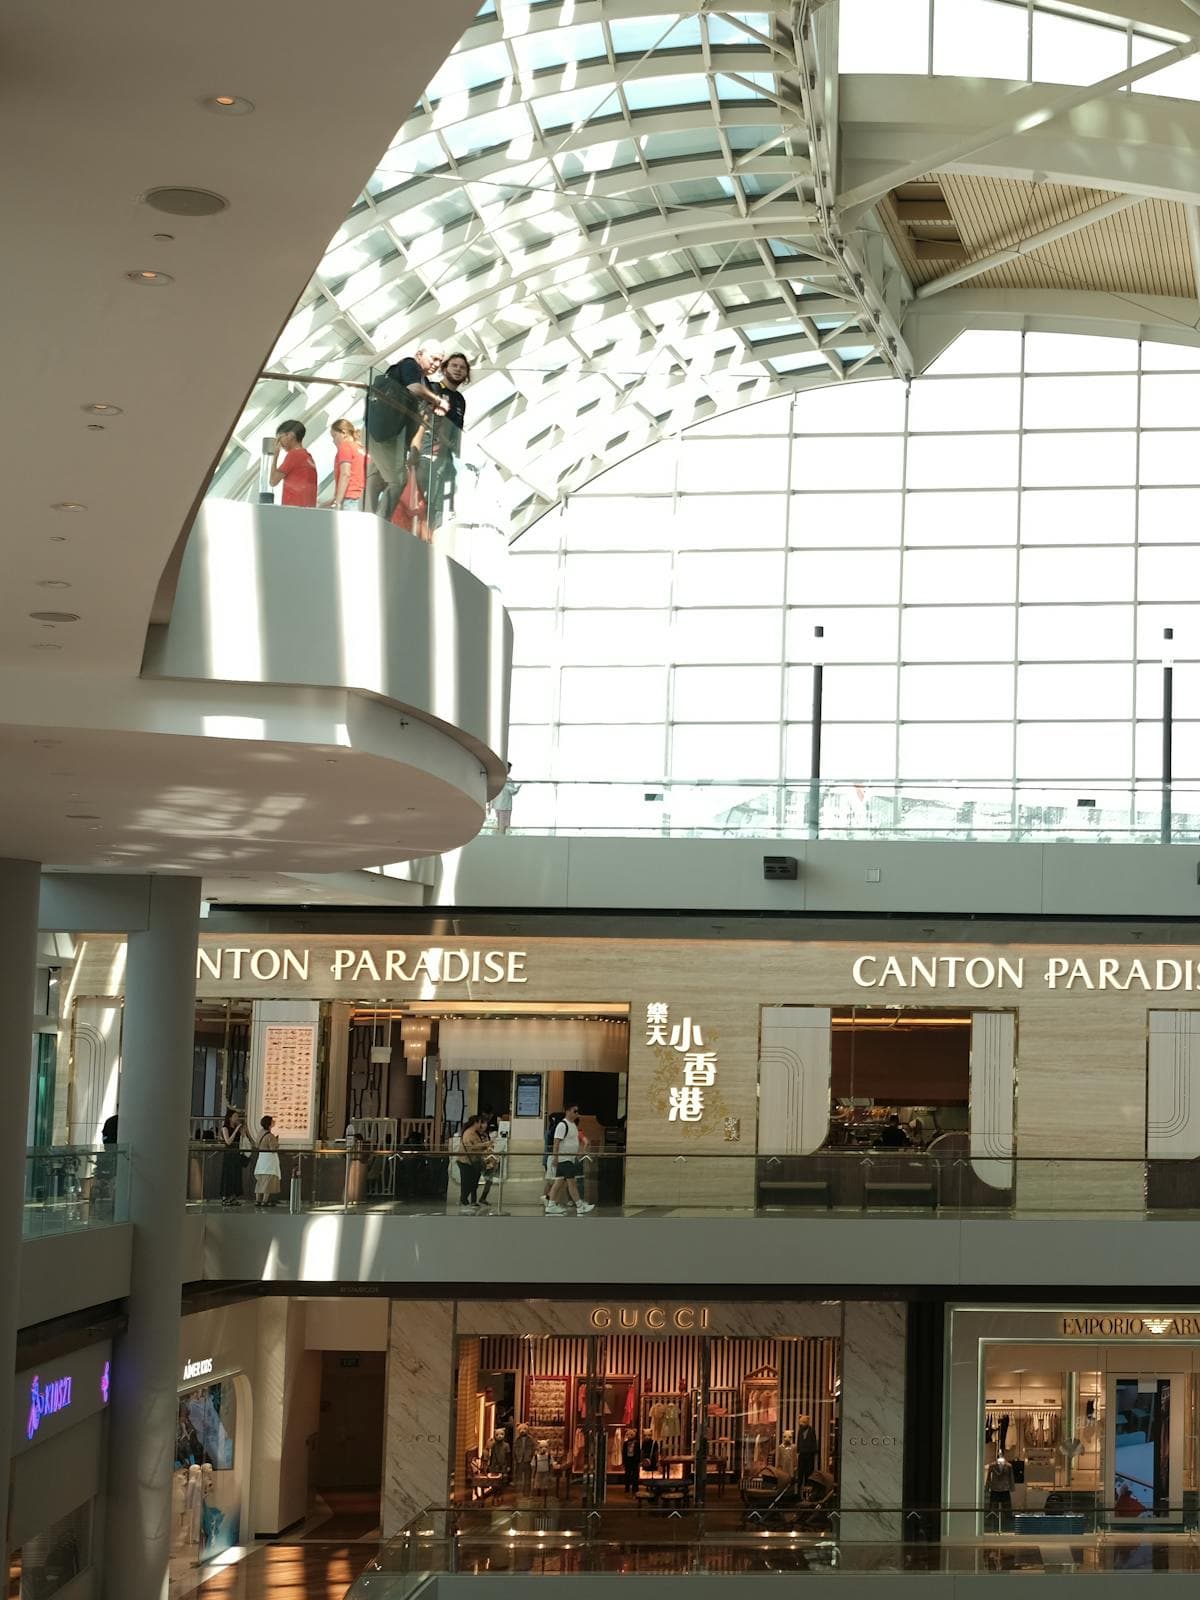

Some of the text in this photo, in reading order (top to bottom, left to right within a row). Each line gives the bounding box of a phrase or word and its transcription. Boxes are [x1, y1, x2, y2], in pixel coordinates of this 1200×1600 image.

[196, 948, 528, 982] NTON PARADISE
[852, 956, 1024, 989] CANTON
[646, 1002, 669, 1046] 樂天
[669, 1017, 718, 1122] 小香港
[591, 1307, 709, 1329] GUCCI
[1063, 1318, 1143, 1336] EMPORIO
[849, 1436, 897, 1447] GUCCI
